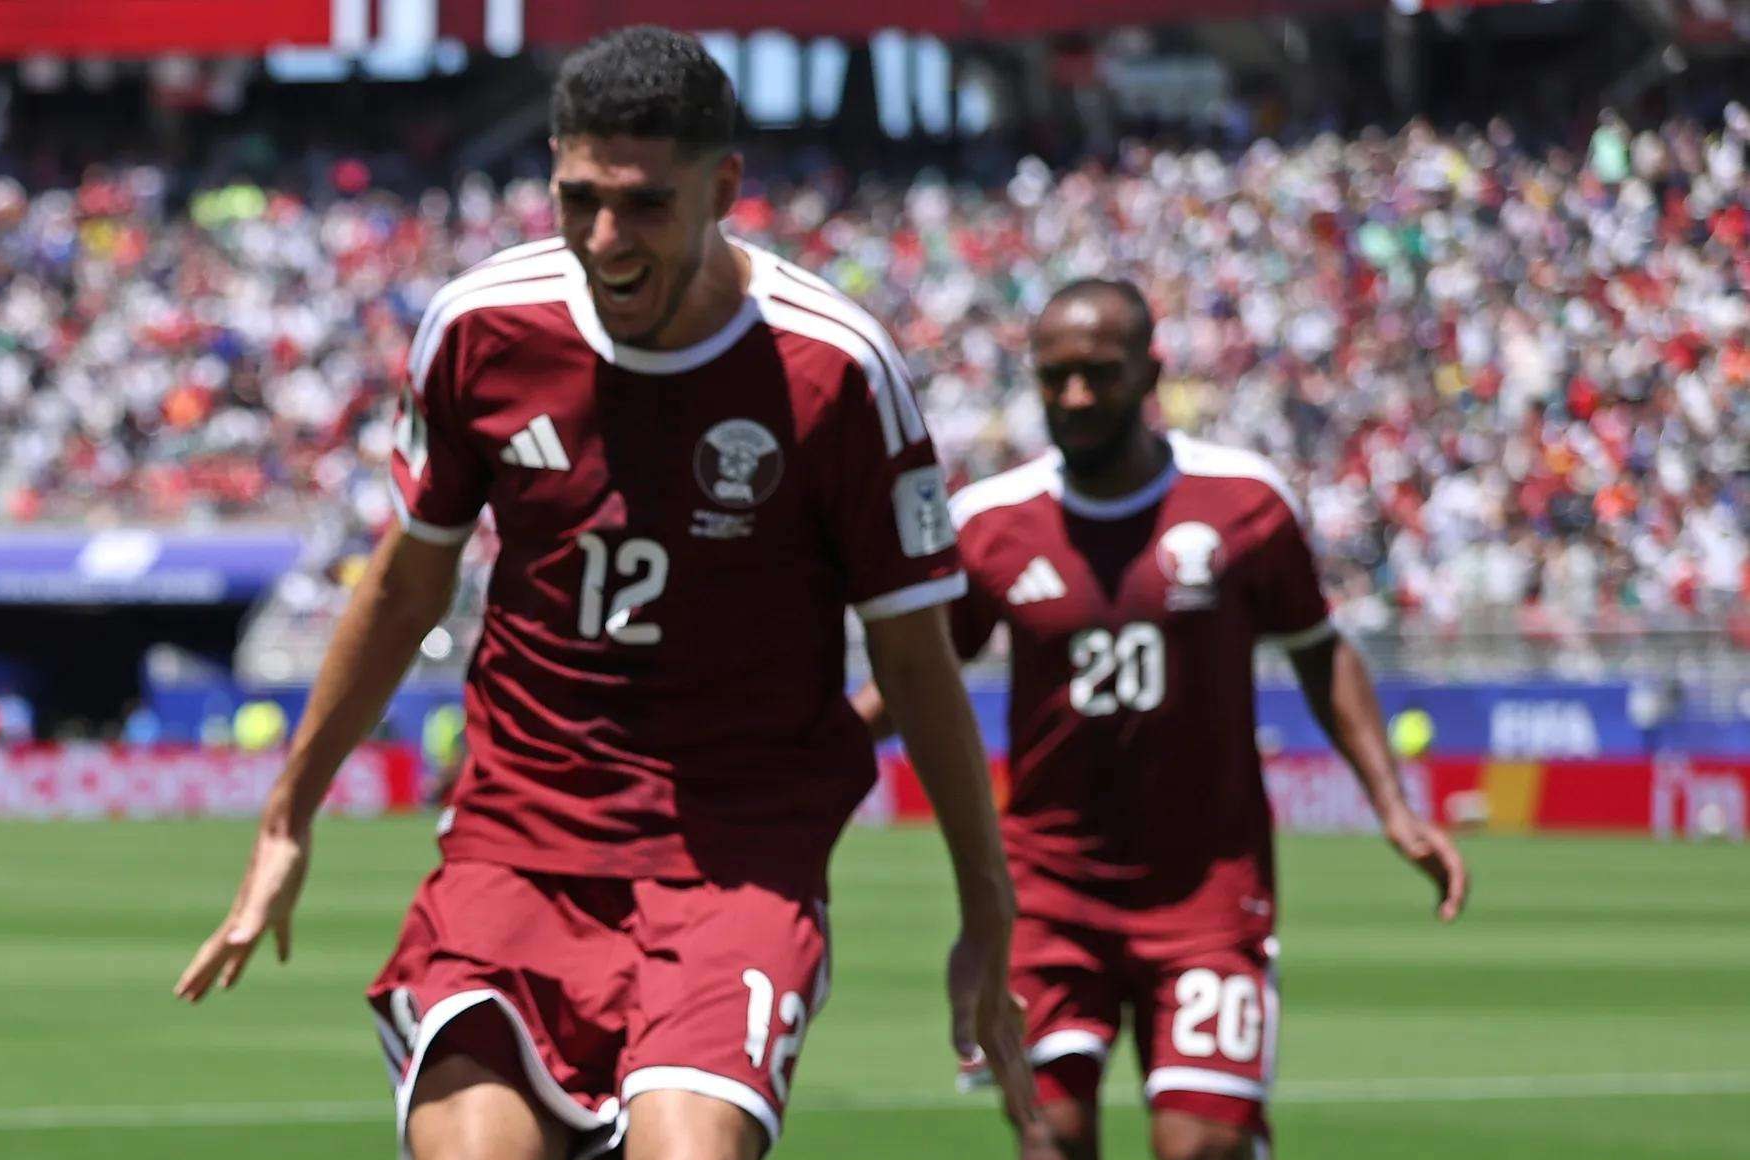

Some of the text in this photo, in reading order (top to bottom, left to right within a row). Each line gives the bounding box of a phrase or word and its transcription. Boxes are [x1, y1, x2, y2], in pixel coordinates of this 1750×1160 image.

[576, 532, 669, 645] 12
[1069, 621, 1165, 717] 20
[742, 967, 808, 1100] 12
[1171, 967, 1263, 1062] 20
